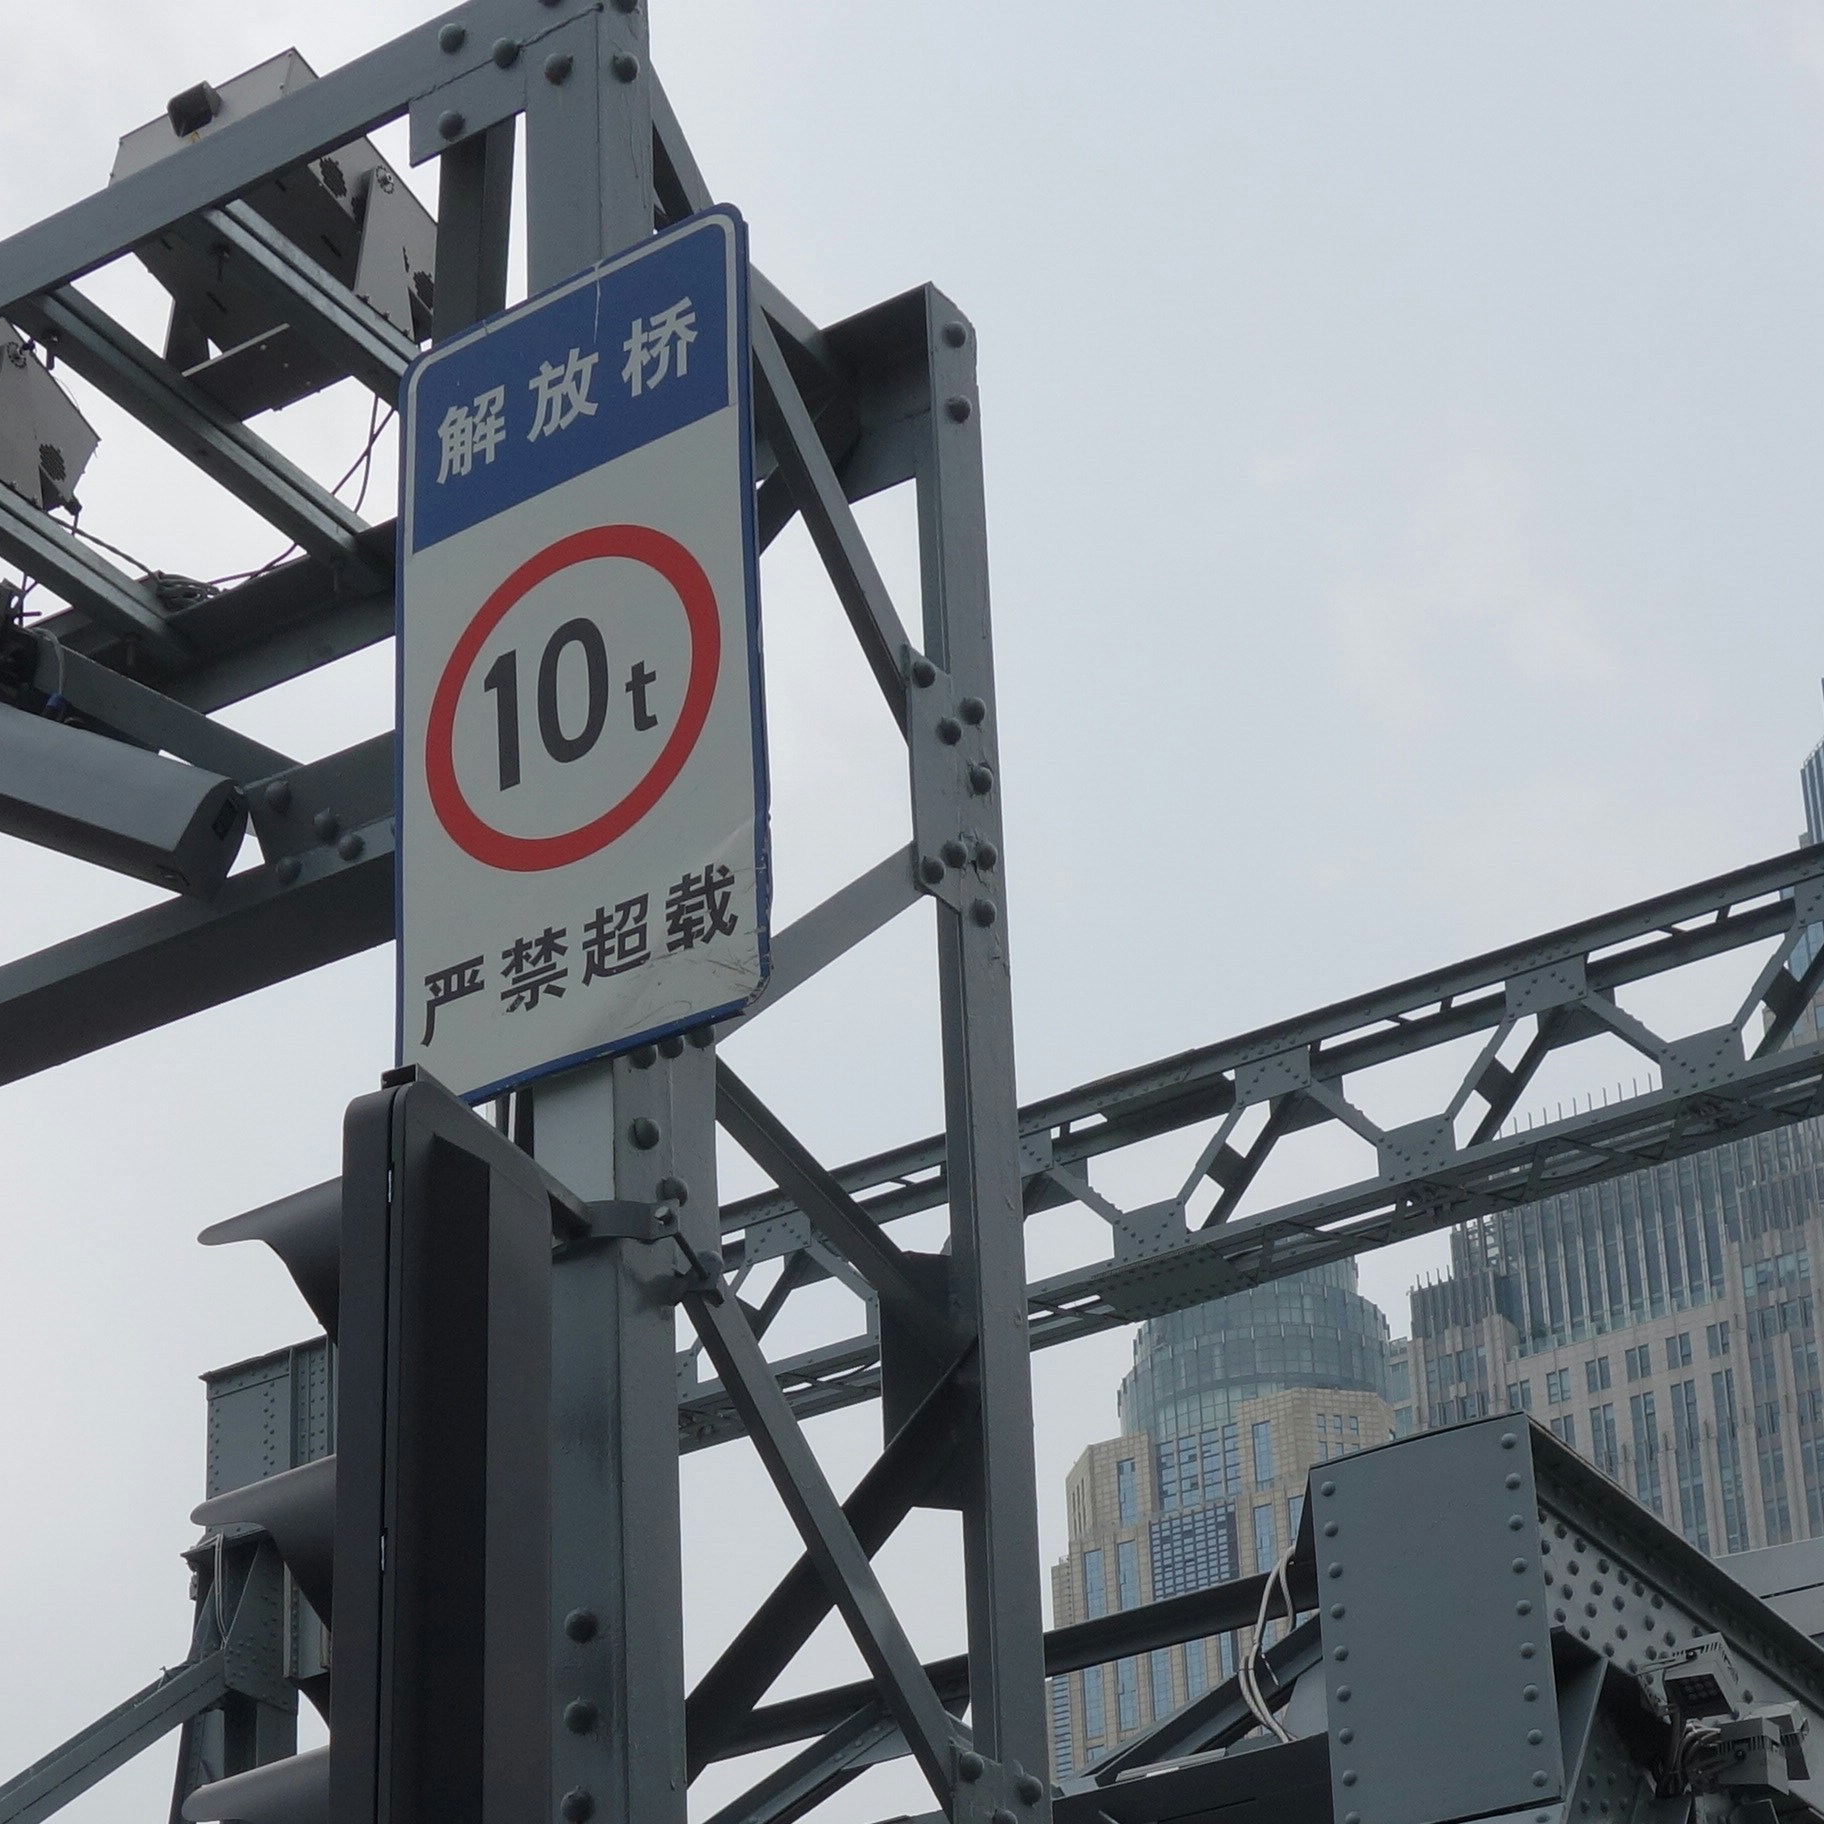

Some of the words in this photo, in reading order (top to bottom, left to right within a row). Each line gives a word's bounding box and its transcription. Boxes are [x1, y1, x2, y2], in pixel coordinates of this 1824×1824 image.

[436, 294, 699, 486] 解放桥
[420, 860, 740, 1048] 严禁超载
